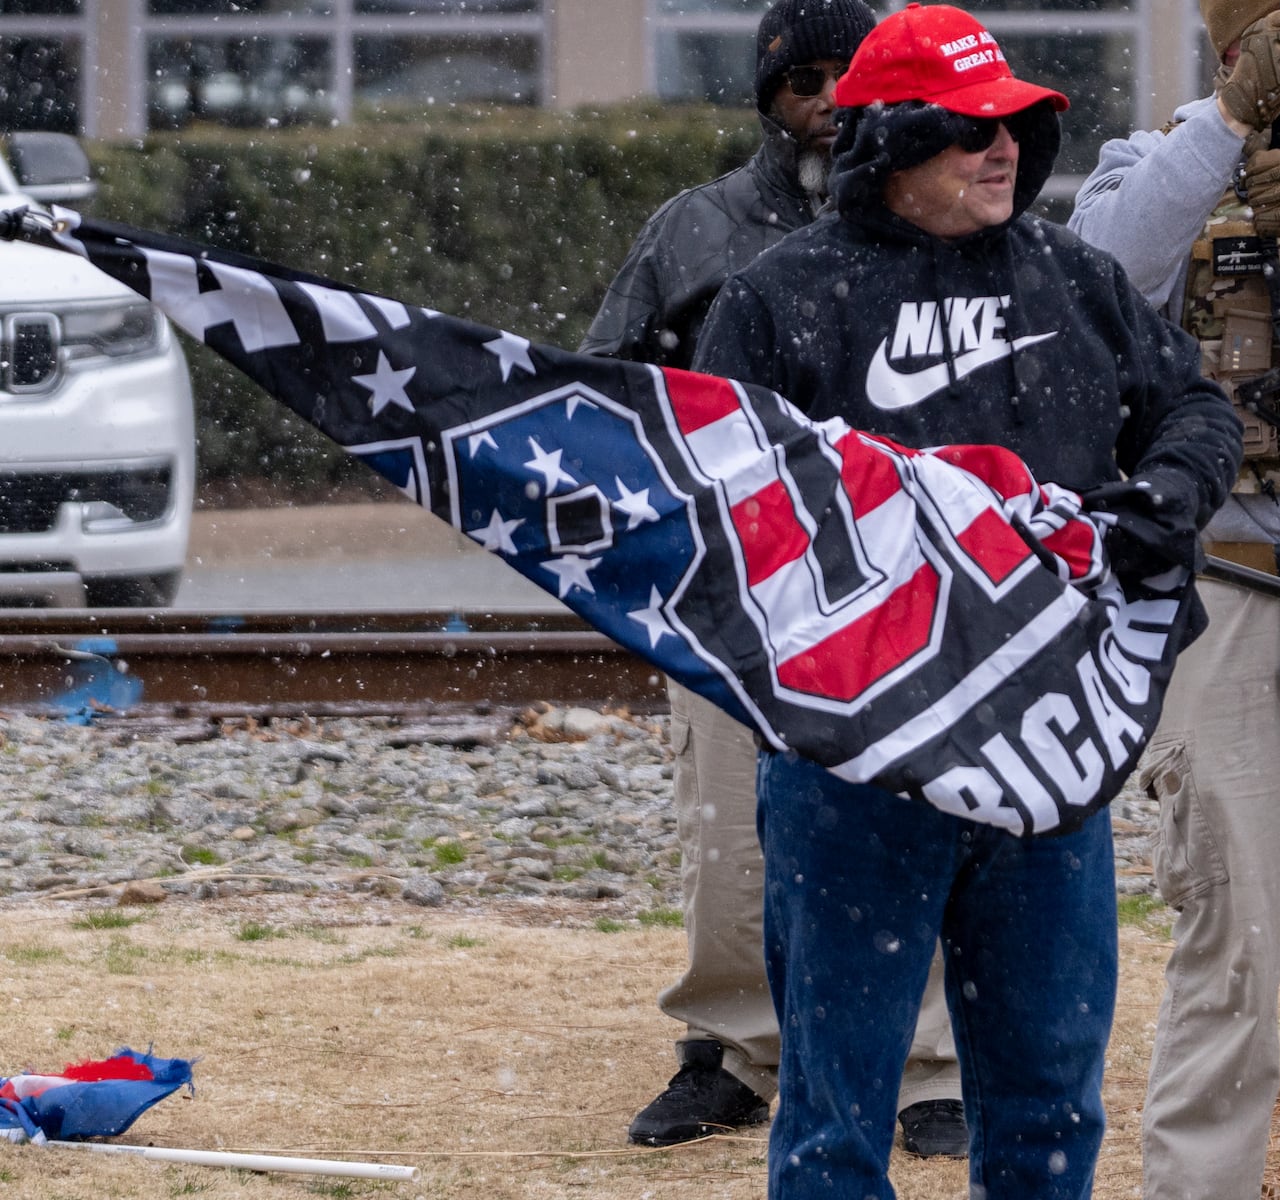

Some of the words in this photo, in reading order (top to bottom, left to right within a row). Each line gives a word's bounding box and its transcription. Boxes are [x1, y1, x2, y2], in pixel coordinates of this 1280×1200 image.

[940, 34, 979, 57] MAKE
[953, 49, 995, 73] GREAT
[890, 295, 1012, 360] NIKE
[905, 650, 1144, 837] RICA
